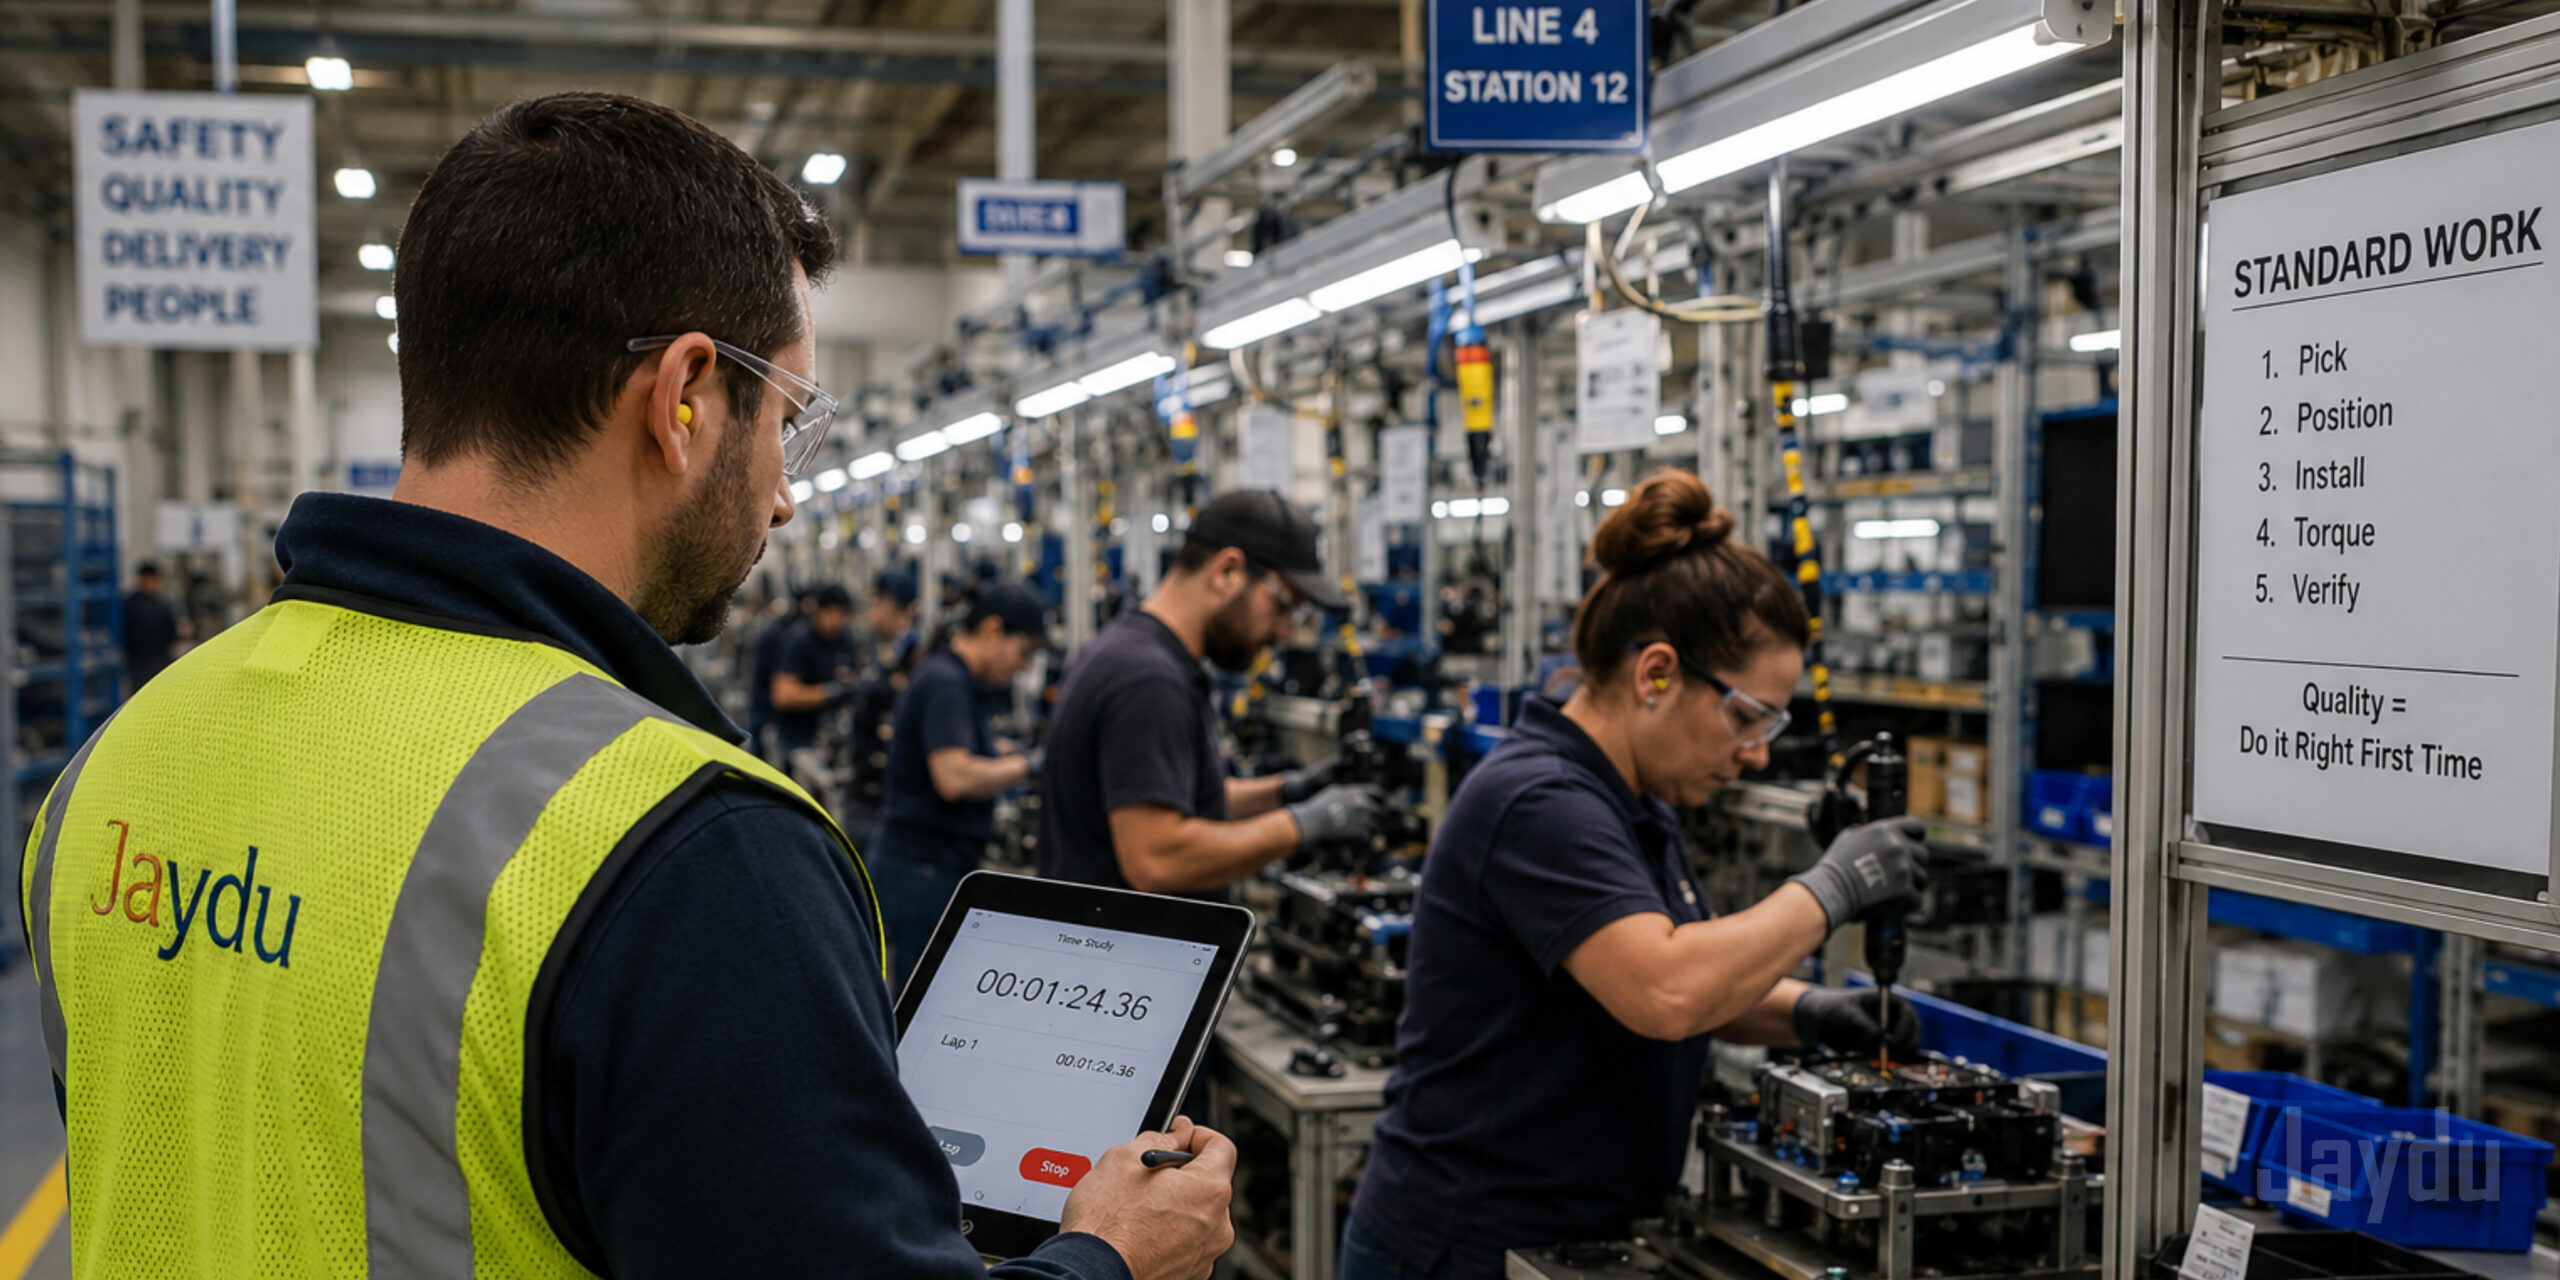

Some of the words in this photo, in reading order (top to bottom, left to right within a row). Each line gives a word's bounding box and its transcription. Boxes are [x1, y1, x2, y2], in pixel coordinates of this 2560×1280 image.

[1473, 7, 1562, 44] LINE
[1572, 8, 1599, 45] 4
[1444, 69, 1582, 103] STATION
[1591, 71, 1629, 104] 12
[101, 114, 284, 160] SAFETY
[102, 172, 285, 215] QUALITY
[104, 229, 292, 270] DELIVERY
[2234, 232, 2412, 298] STANDARD
[2424, 207, 2542, 268] WORK
[105, 285, 261, 326] PEOPLE
[2262, 350, 2278, 379] 1.
[2300, 341, 2347, 376] Pick
[2259, 405, 2278, 435] 2.
[2297, 396, 2393, 433] Position
[2258, 462, 2276, 492] 3.
[2296, 456, 2365, 490] Install
[2256, 518, 2275, 547] 4.
[2294, 516, 2375, 555] Torque
[2255, 574, 2273, 603] 5.
[2292, 573, 2360, 613] Verify
[2303, 681, 2384, 724] Quality
[2240, 725, 2268, 755] Do
[2274, 728, 2289, 758] it
[2295, 731, 2354, 770] Right
[2361, 738, 2413, 772] First
[2421, 743, 2482, 780] Time
[91, 819, 302, 969] Jaydu
[1057, 932, 1083, 947] Time
[1085, 938, 1115, 952] Study
[976, 968, 1152, 1021] 00:01:24.36
[940, 1033, 968, 1050] Lap
[970, 1038, 979, 1050] 1
[1055, 1053, 1136, 1079] 00:01:24.36
[1040, 1160, 1070, 1178] Stop
